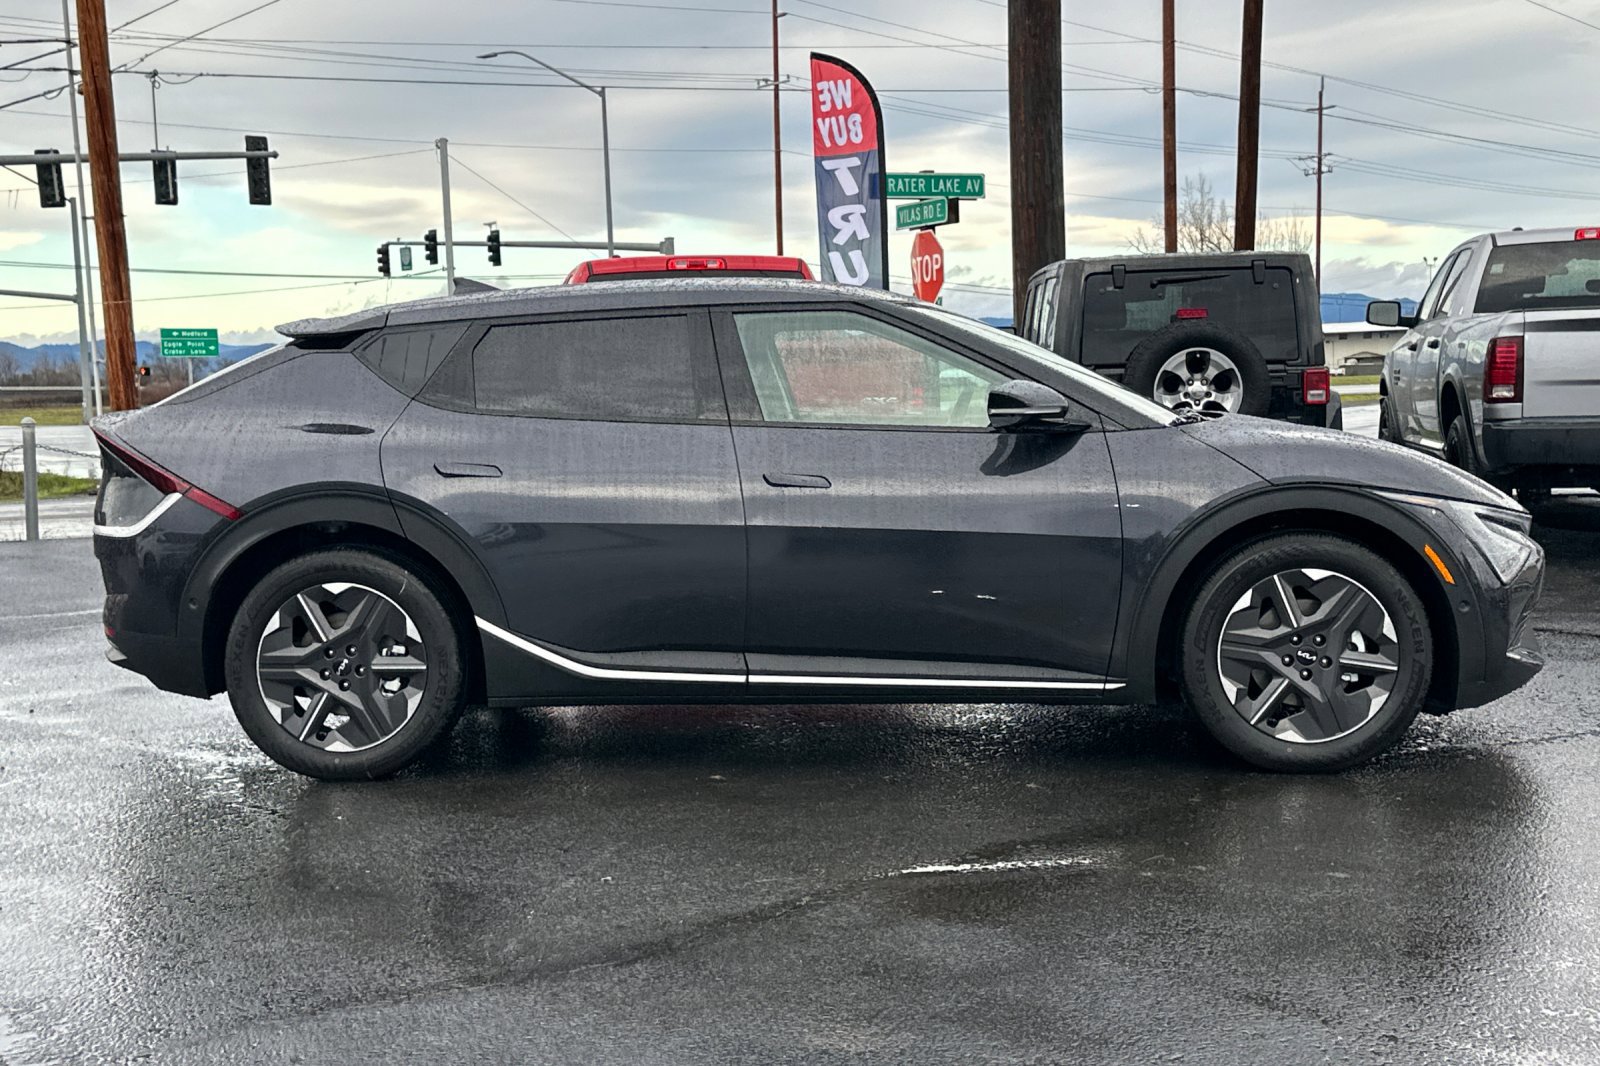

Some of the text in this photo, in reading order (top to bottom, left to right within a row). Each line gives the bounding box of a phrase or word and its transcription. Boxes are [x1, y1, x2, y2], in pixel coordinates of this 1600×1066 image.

[887, 178, 981, 193] RATER LAKE AV
[899, 206, 921, 224] VILAS
[923, 205, 935, 220] RD
[911, 253, 942, 285] STOP
[1393, 587, 1425, 654] NEXEN
